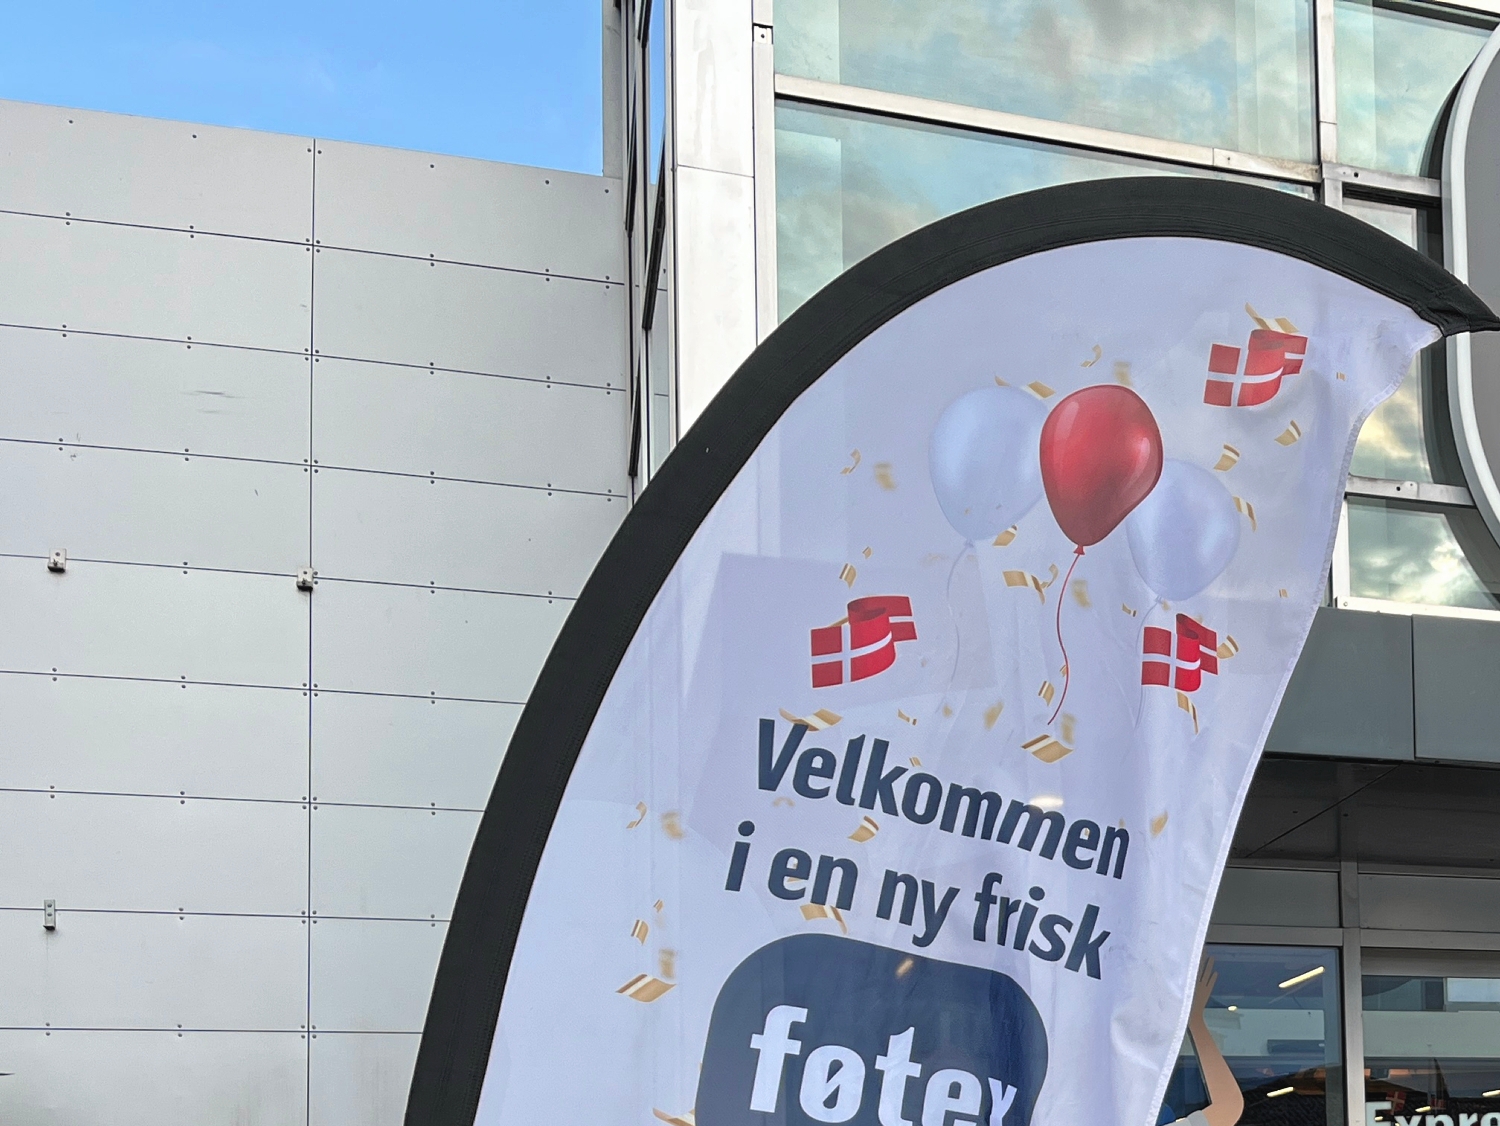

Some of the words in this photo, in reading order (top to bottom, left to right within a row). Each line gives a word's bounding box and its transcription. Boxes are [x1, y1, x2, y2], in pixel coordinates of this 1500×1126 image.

[758, 717, 1130, 880] Velkommen
[725, 820, 755, 893] i
[767, 847, 858, 911] en
[876, 869, 961, 948] ny
[973, 871, 1111, 981] frisk
